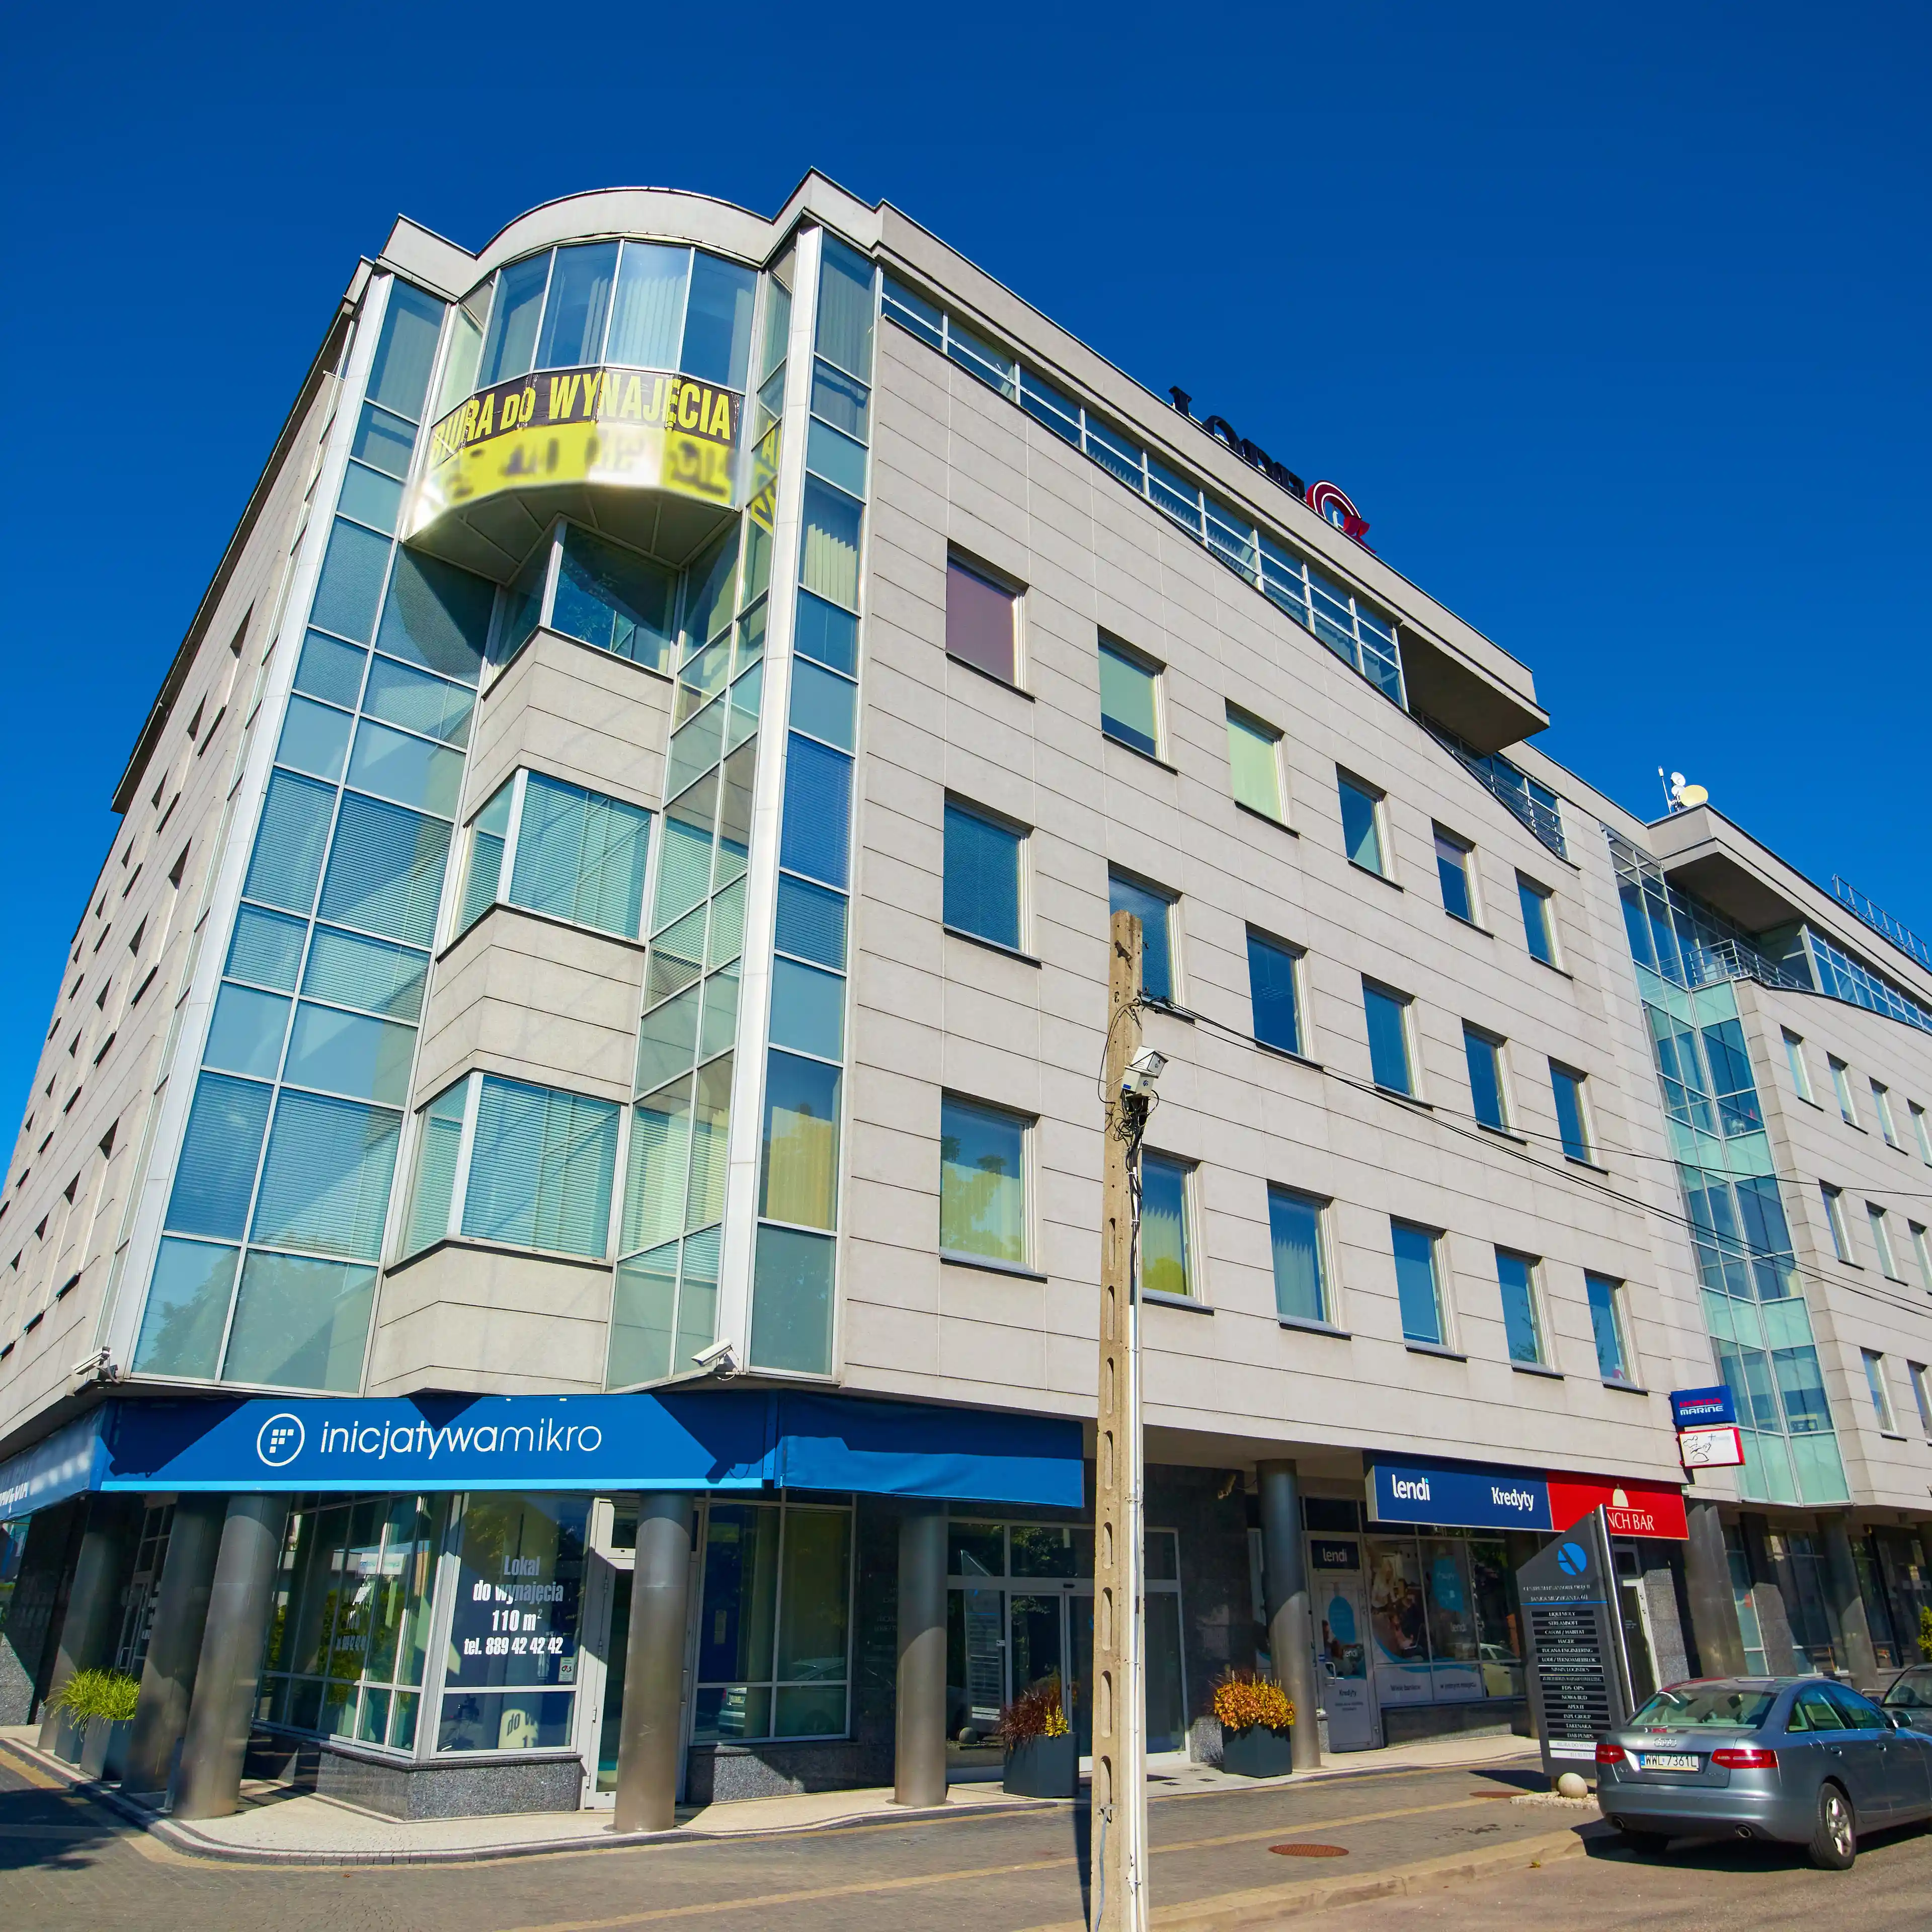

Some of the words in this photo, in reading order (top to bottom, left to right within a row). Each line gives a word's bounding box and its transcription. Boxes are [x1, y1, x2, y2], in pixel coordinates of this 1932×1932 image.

[500, 386, 536, 431] DO
[1679, 1398, 1723, 1408] HONDA
[320, 1418, 602, 1460] inicjatywamikro
[1392, 1474, 1430, 1502] lendi
[1491, 1486, 1534, 1511] Kredyty
[1633, 1513, 1655, 1531] BAR
[504, 1555, 541, 1576] Lokal
[1322, 1548, 1348, 1563] lendi
[473, 1579, 491, 1602] do
[495, 1581, 564, 1604] wynajęcia
[492, 1610, 519, 1631] 110
[464, 1637, 482, 1655] tel.
[486, 1637, 509, 1655] 889
[511, 1637, 527, 1654] 42
[529, 1637, 546, 1654] 42
[547, 1637, 564, 1654] 42
[1646, 1754, 1664, 1765] WWL
[1667, 1755, 1697, 1767] 7361L
